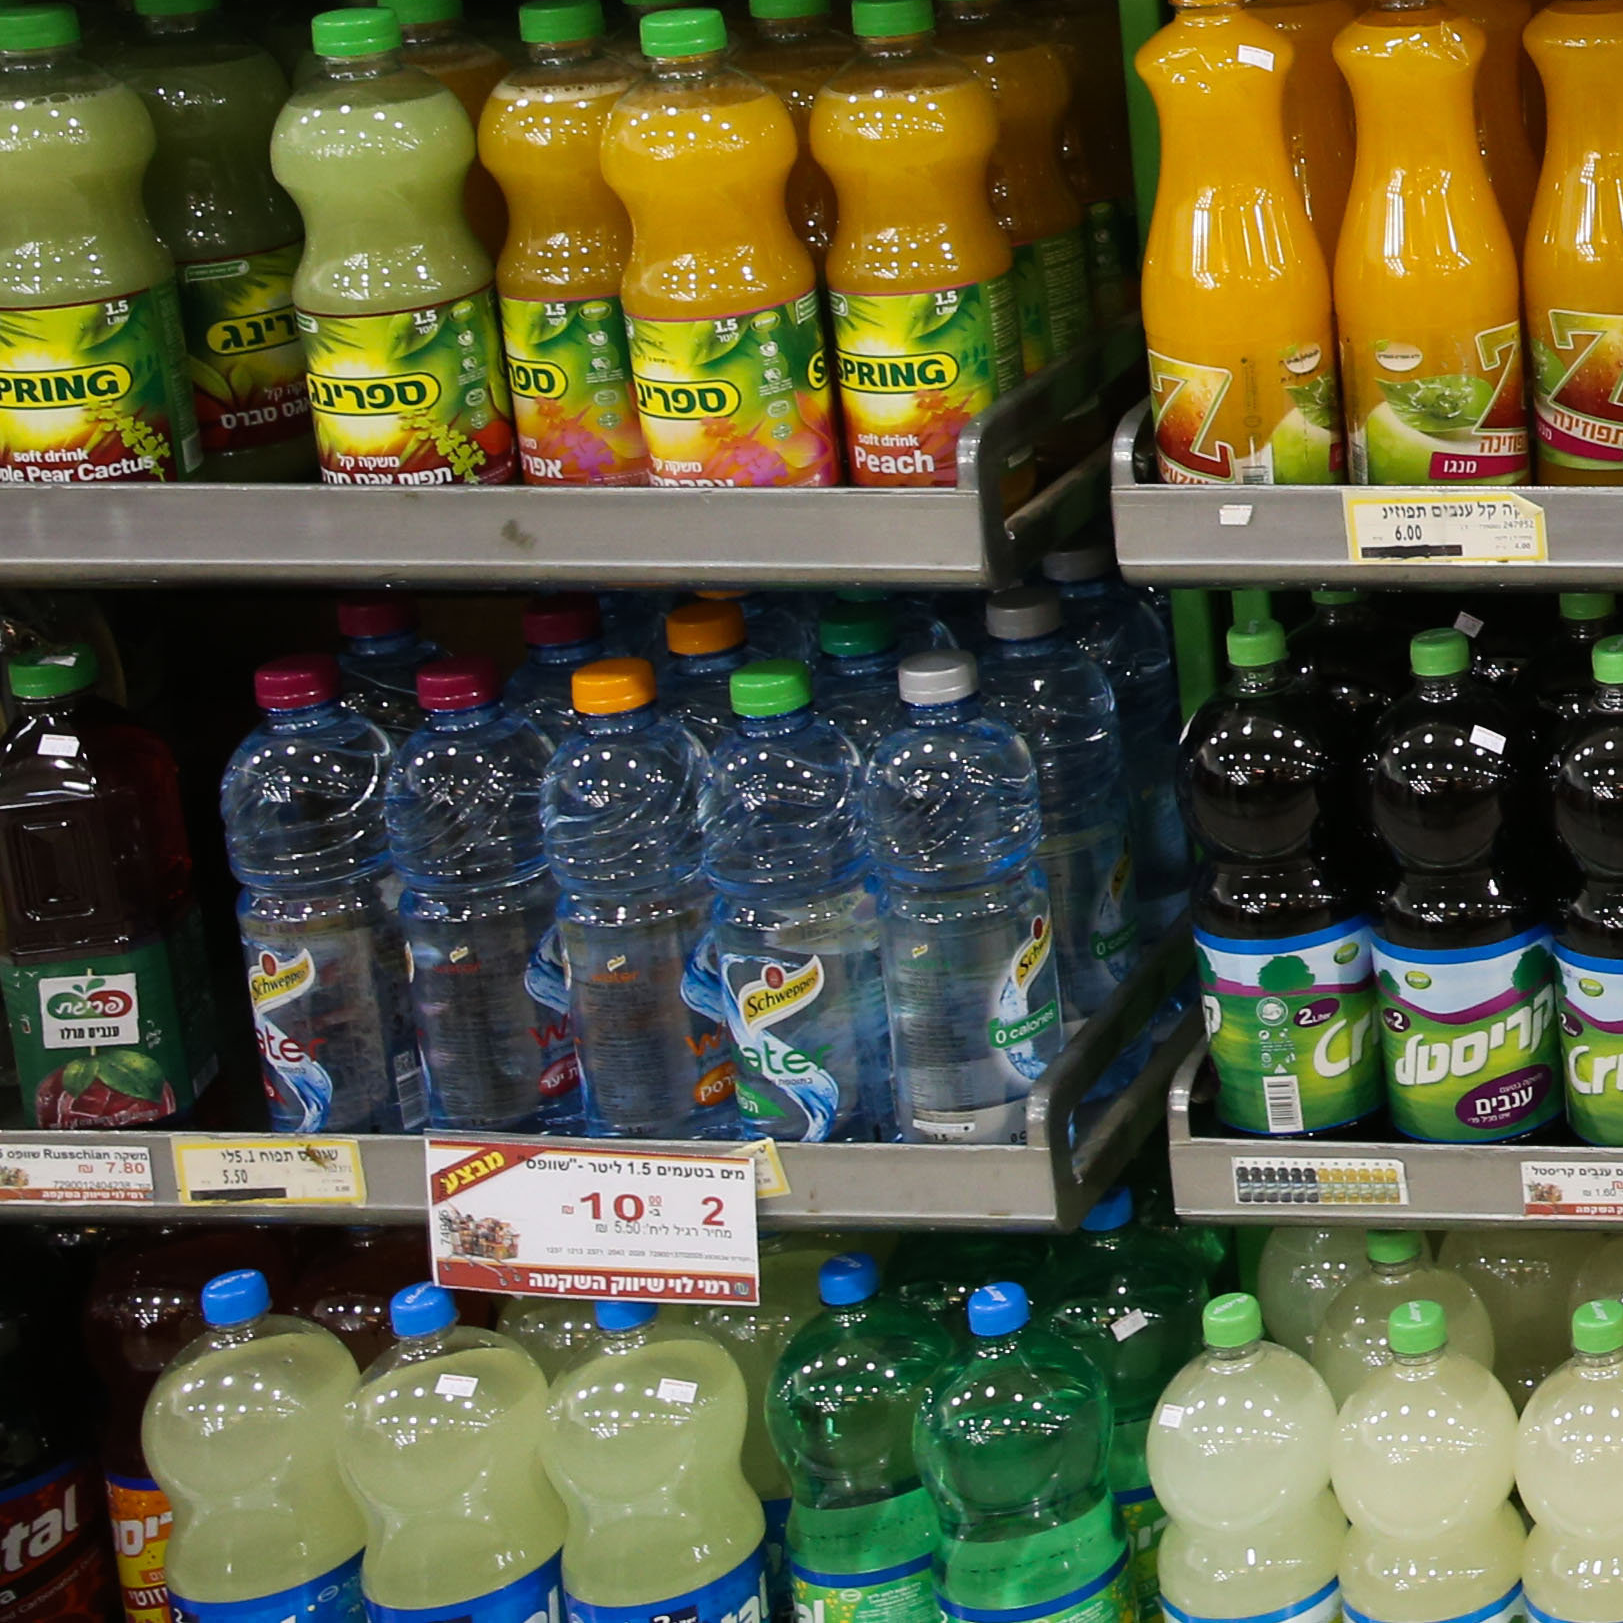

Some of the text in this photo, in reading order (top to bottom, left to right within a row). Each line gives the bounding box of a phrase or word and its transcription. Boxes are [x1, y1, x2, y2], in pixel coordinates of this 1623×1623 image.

[104, 300, 128, 315] 1.5
[857, 433, 919, 447] soft drink
[13, 448, 88, 463] soft drink
[854, 446, 935, 473] Peach
[26, 455, 154, 483] Pear Cactus
[1443, 459, 1478, 474] מנגו
[1431, 503, 1473, 519] ענבים
[1477, 502, 1497, 519] קל
[1395, 526, 1422, 541] 6.00
[746, 968, 818, 1018] Schweppes
[1474, 1087, 1534, 1116] ענבים
[44, 1148, 110, 1159] Russchian
[106, 1163, 145, 1174] 7.80
[441, 1151, 505, 1195] מבצע
[587, 1160, 745, 1180] מים בטעמים 1.5 ליטר
[222, 1170, 248, 1184] 5.50
[580, 1192, 646, 1222] 10
[648, 1194, 662, 1206] 00
[701, 1196, 725, 1227] 2
[673, 1225, 732, 1239] מחיר רגיל
[528, 1272, 731, 1295] רמי לוי שיווק השקמה
